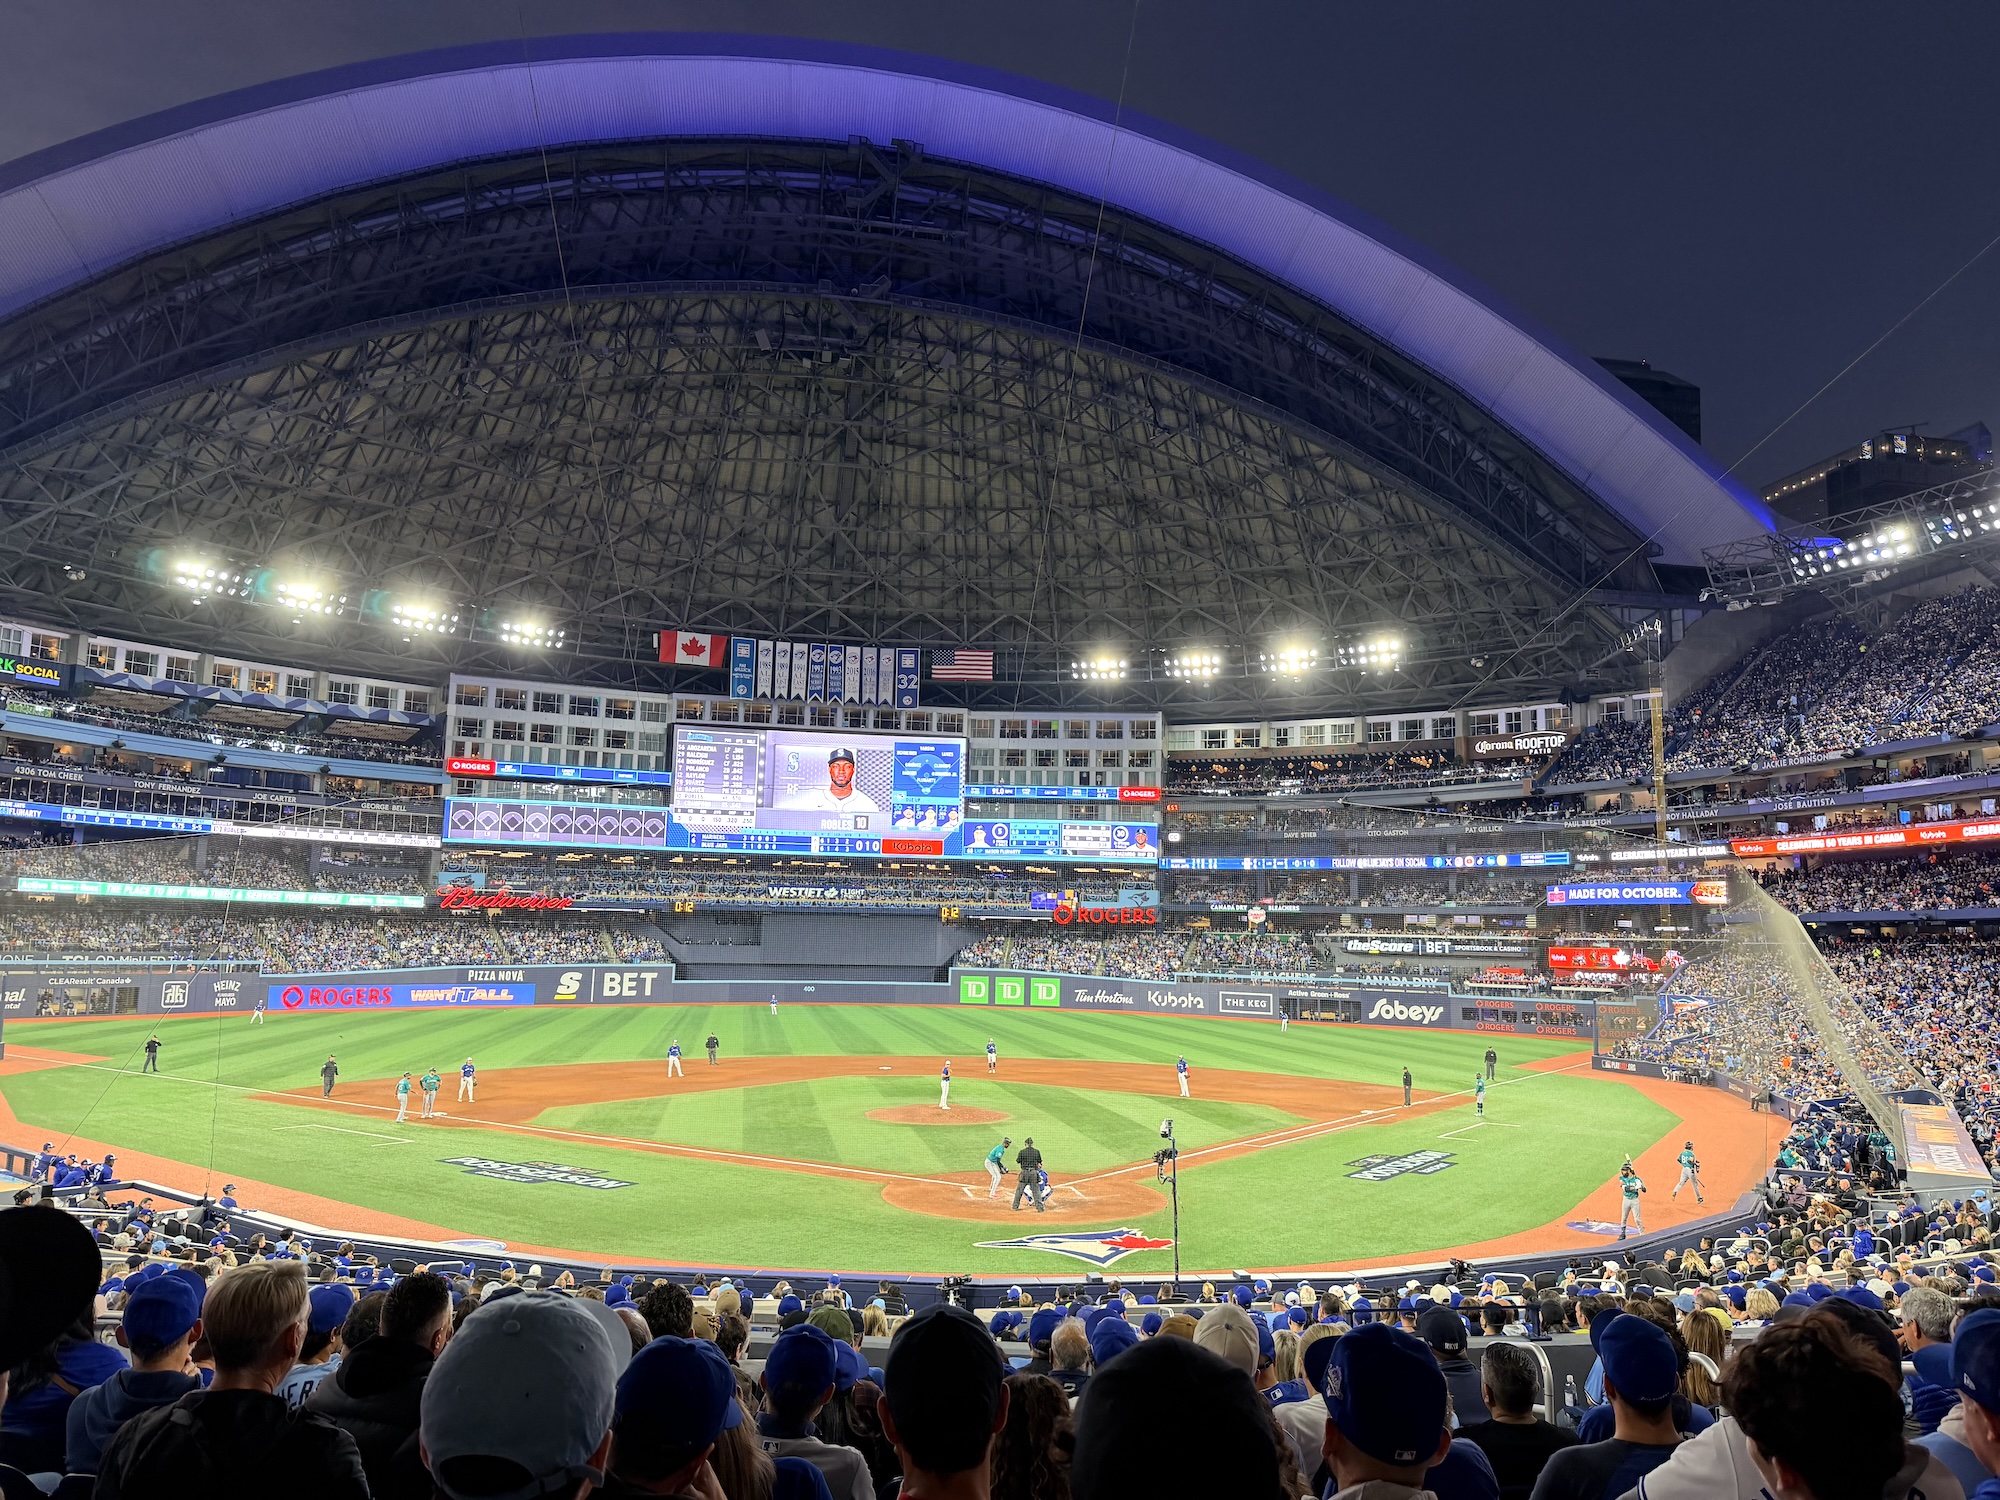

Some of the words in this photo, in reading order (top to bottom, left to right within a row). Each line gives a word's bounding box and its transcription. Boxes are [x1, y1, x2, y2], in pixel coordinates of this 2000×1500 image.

[16, 664, 60, 680] SOCIAL
[830, 666, 841, 674] 1993
[846, 667, 859, 675] 2015
[898, 674, 918, 689] 32
[1475, 740, 1514, 754] Corona
[1515, 736, 1565, 750] ROOFTOP
[787, 752, 799, 772] S
[1762, 758, 1787, 769] JACKIE
[1788, 754, 1829, 766] ROBINSON
[14, 766, 35, 776] 4306
[37, 769, 57, 778] TOM
[58, 771, 84, 781] CHEEK
[134, 780, 155, 789] TONY
[158, 783, 201, 794] FERNANDEZ
[787, 783, 799, 795] RF
[270, 794, 297, 803] CARTER
[1773, 801, 1793, 810] JOSÉ
[1796, 798, 1836, 808] BAUTISTA
[361, 802, 389, 810] GEORGE
[10, 808, 42, 818] FLUHARTY
[1682, 810, 1719, 819] HALLADAY
[821, 819, 853, 830] ROBLES
[856, 818, 867, 828] 10
[872, 841, 879, 852] 0
[893, 842, 931, 852] Kubota
[1776, 838, 1824, 851] CELEBRATING
[1826, 838, 1836, 847] 50
[1837, 835, 1862, 847] YEARS
[1864, 835, 1873, 845] IN
[1874, 833, 1906, 845] CANADA
[1920, 831, 1946, 839] Kubota
[1611, 850, 1656, 860] CELEBRATING
[1657, 850, 1666, 858] 50
[1666, 849, 1688, 858] YEARS
[1689, 849, 1698, 857] IN
[1698, 846, 1726, 856] CANADA
[1332, 857, 1356, 867] FOLLOW
[1357, 857, 1394, 868] @BLUEJAYS
[1395, 857, 1404, 867] ON
[1405, 857, 1427, 867] SOCIAL
[106, 885, 122, 893] THE
[124, 886, 150, 895] PLACE
[153, 887, 164, 896] TO
[167, 888, 184, 896] BUY
[186, 888, 208, 897] YOUR
[768, 886, 823, 898] WESTJET
[1569, 889, 1595, 899] MADE
[1597, 888, 1620, 898] FOR
[1622, 887, 1682, 898] OCTOBER.
[436, 886, 573, 909] Budweiser
[675, 902, 694, 912] 0:12
[942, 908, 959, 918] 0:12
[1077, 908, 1156, 924] ROGERS
[1347, 939, 1414, 952] theScore
[1426, 942, 1451, 953] BET
[468, 970, 495, 981] PIZZA
[498, 970, 524, 982] NOVA
[213, 980, 241, 992] HEINZ
[556, 972, 582, 994] S
[603, 972, 658, 996] BET
[964, 981, 986, 998] TD
[998, 982, 1021, 998] TD
[310, 988, 392, 1006] ROGERS
[411, 989, 452, 1002] WANT
[473, 989, 514, 1001] ALL
[1034, 982, 1056, 1000] TD
[1074, 989, 1094, 1003] Tim
[1093, 990, 1133, 1004] Hortons
[1288, 989, 1308, 998] Active
[215, 998, 236, 1006] MAYO
[1148, 991, 1204, 1009] Kubota
[1225, 998, 1245, 1007] THE
[1248, 999, 1267, 1008] KEG
[1485, 1001, 1514, 1009] ROGERS
[1368, 998, 1443, 1024] Sobeys
[1545, 1004, 1576, 1012] ROGERS
[1608, 1006, 1641, 1014] ROGERS
[1546, 1026, 1577, 1035] ROGERS
[1350, 1150, 1451, 1180] POSTSEASON
[444, 1157, 630, 1188] POSTSEASON
